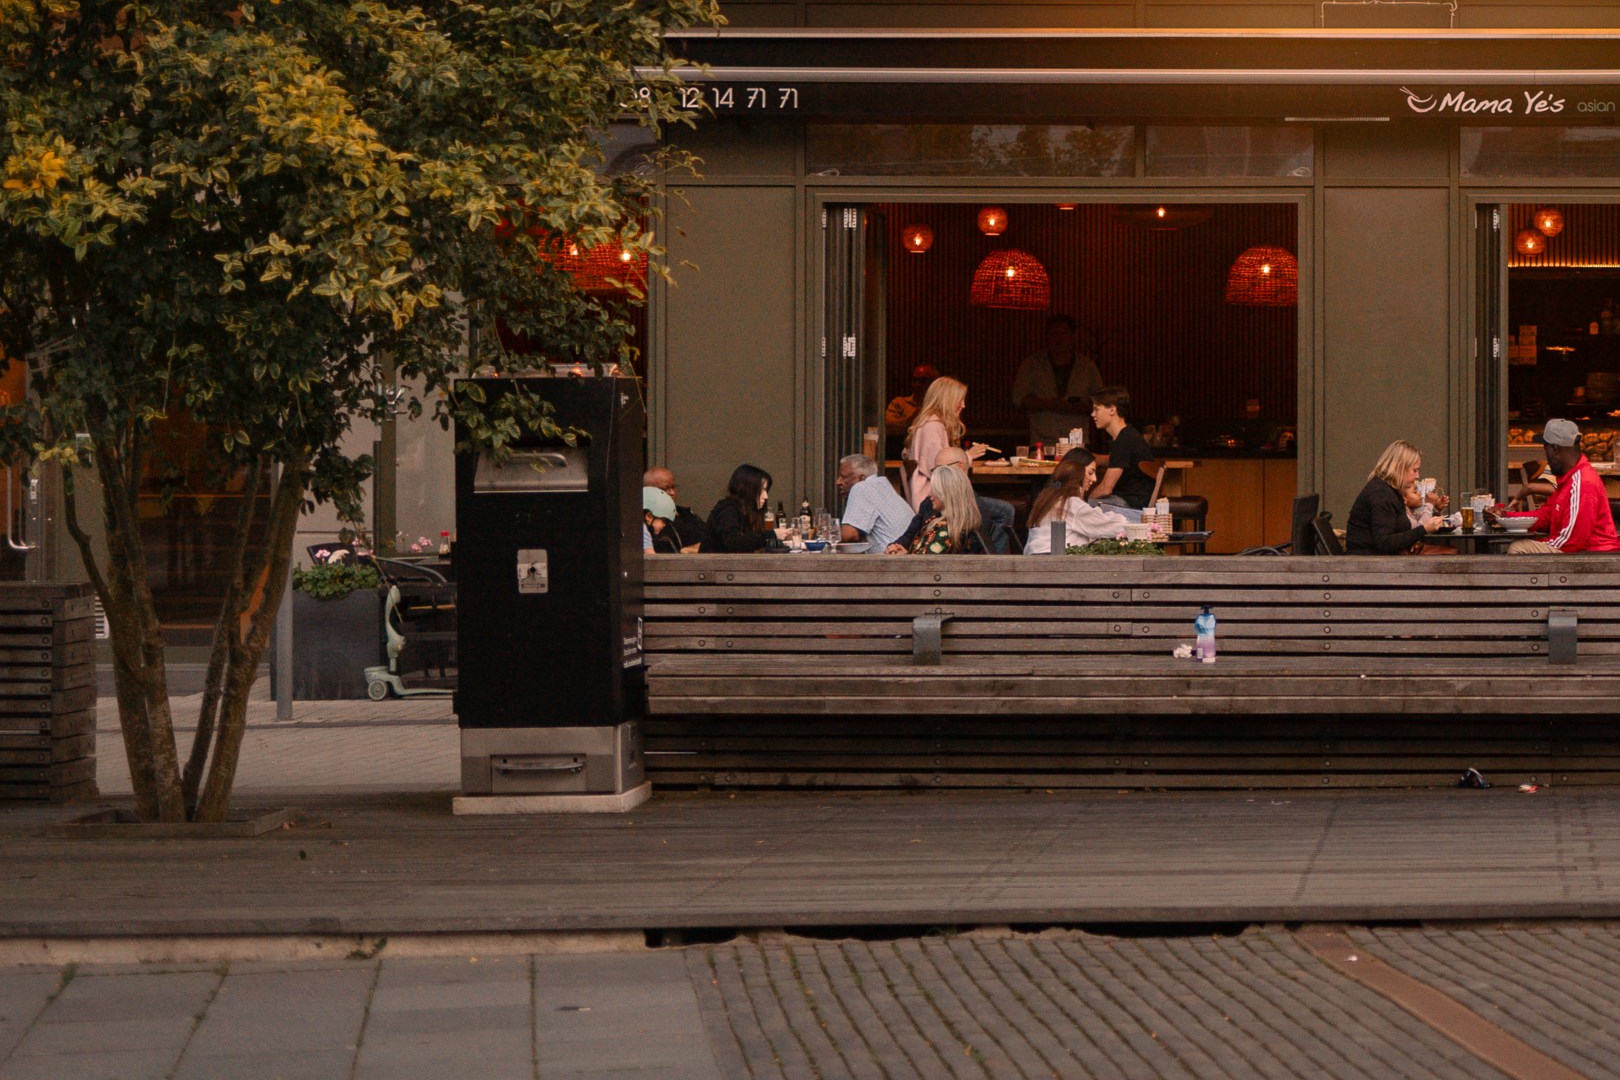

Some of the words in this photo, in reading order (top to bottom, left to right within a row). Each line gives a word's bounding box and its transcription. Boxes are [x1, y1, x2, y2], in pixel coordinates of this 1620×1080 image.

[712, 87, 735, 108] 14
[746, 87, 766, 109] 71
[778, 87, 799, 109] 71
[1438, 91, 1513, 114] Mama
[1523, 90, 1566, 115] Ye's
[1577, 99, 1616, 113] asian
